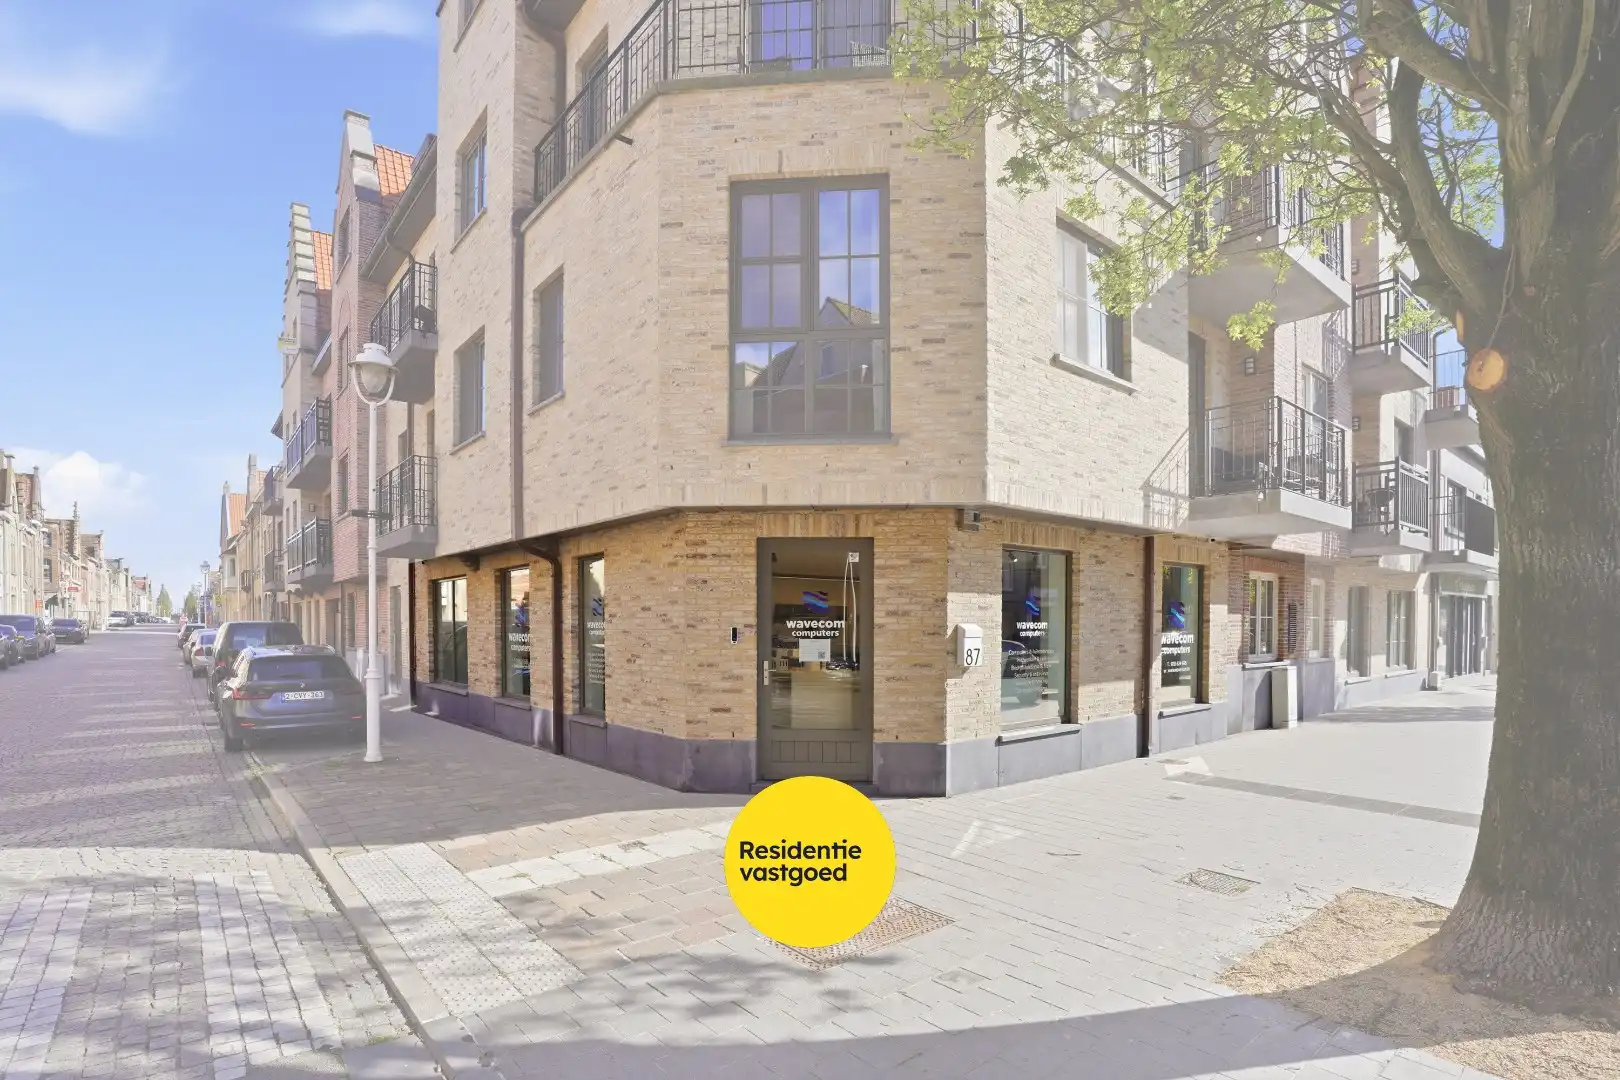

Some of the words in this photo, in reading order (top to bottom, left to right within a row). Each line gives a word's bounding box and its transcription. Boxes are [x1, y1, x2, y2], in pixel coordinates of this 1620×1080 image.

[786, 620, 845, 629] wavecom
[1016, 621, 1048, 630] wavecom
[792, 629, 839, 638] computers
[1161, 634, 1194, 644] wavecom
[966, 648, 980, 665] 87
